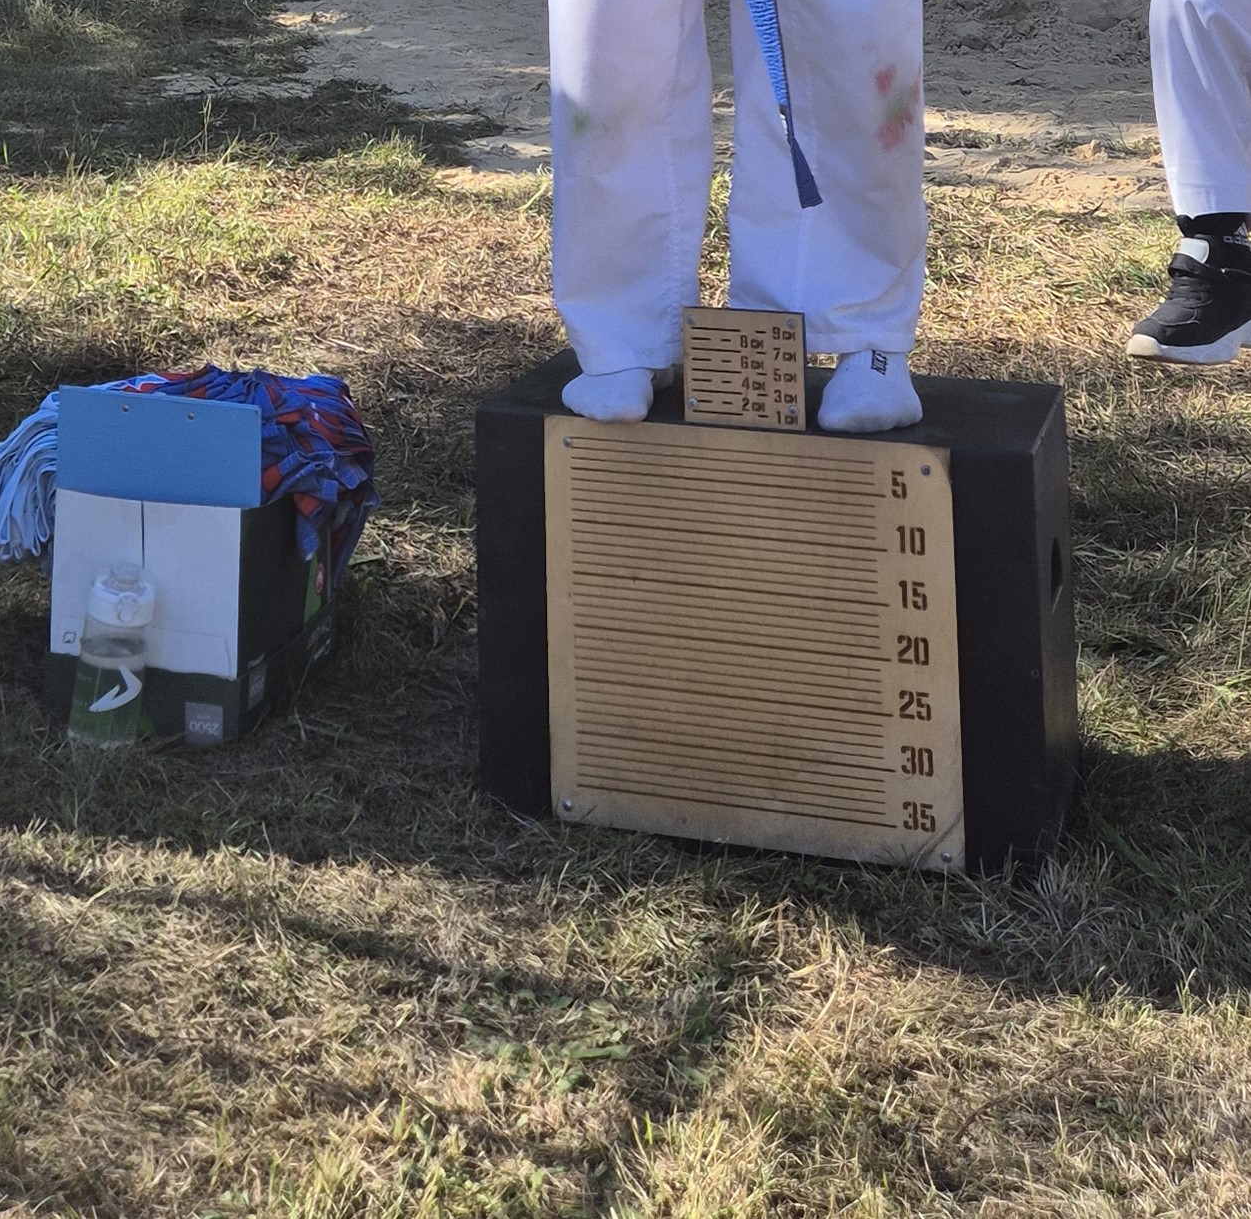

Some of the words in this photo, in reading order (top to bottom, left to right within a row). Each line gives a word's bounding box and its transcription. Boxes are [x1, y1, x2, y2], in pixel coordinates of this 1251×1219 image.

[892, 471, 907, 499] 5
[897, 526, 925, 555] 10
[899, 580, 927, 610] 15
[897, 635, 929, 665] 20
[899, 690, 931, 721] 25
[901, 746, 933, 777] 30
[903, 802, 935, 832] 35
